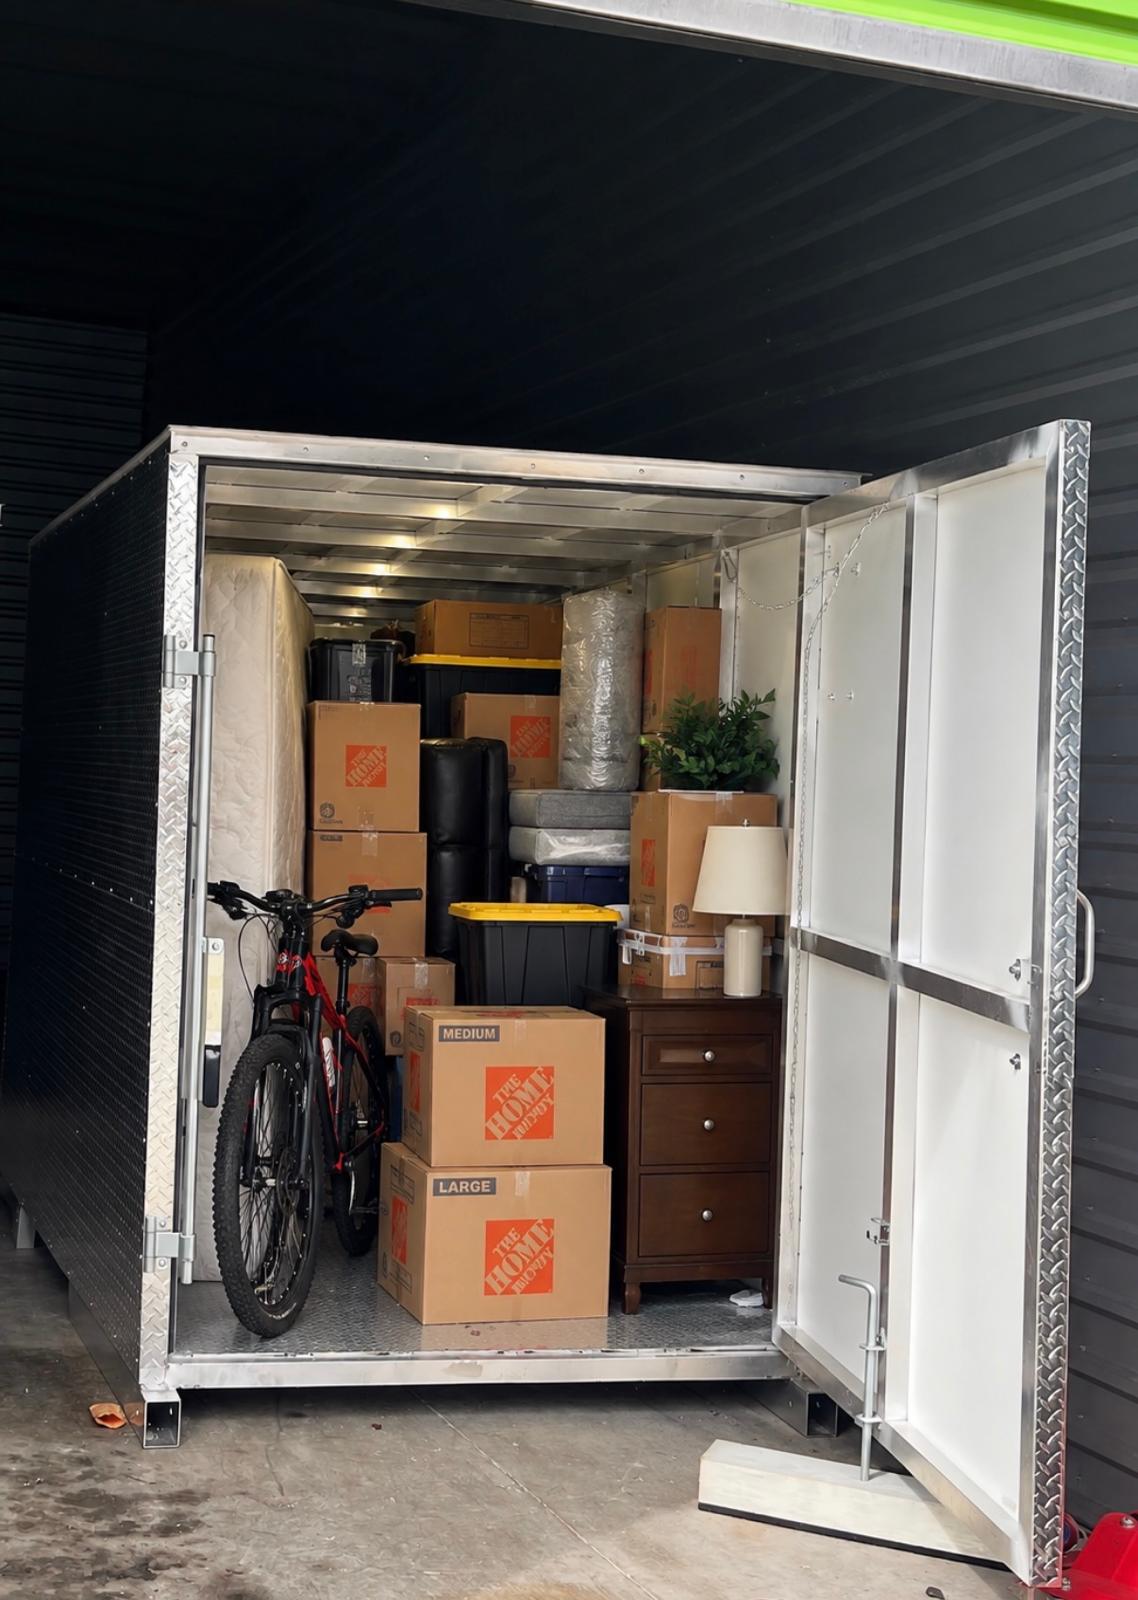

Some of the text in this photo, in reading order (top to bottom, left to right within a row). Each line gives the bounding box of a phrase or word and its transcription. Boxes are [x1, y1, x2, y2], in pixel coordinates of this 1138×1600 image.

[442, 1028, 496, 1040] MEDIUM
[485, 1066, 554, 1139] HOME
[438, 1180, 491, 1193] LARGE
[484, 1219, 554, 1294] HOME
